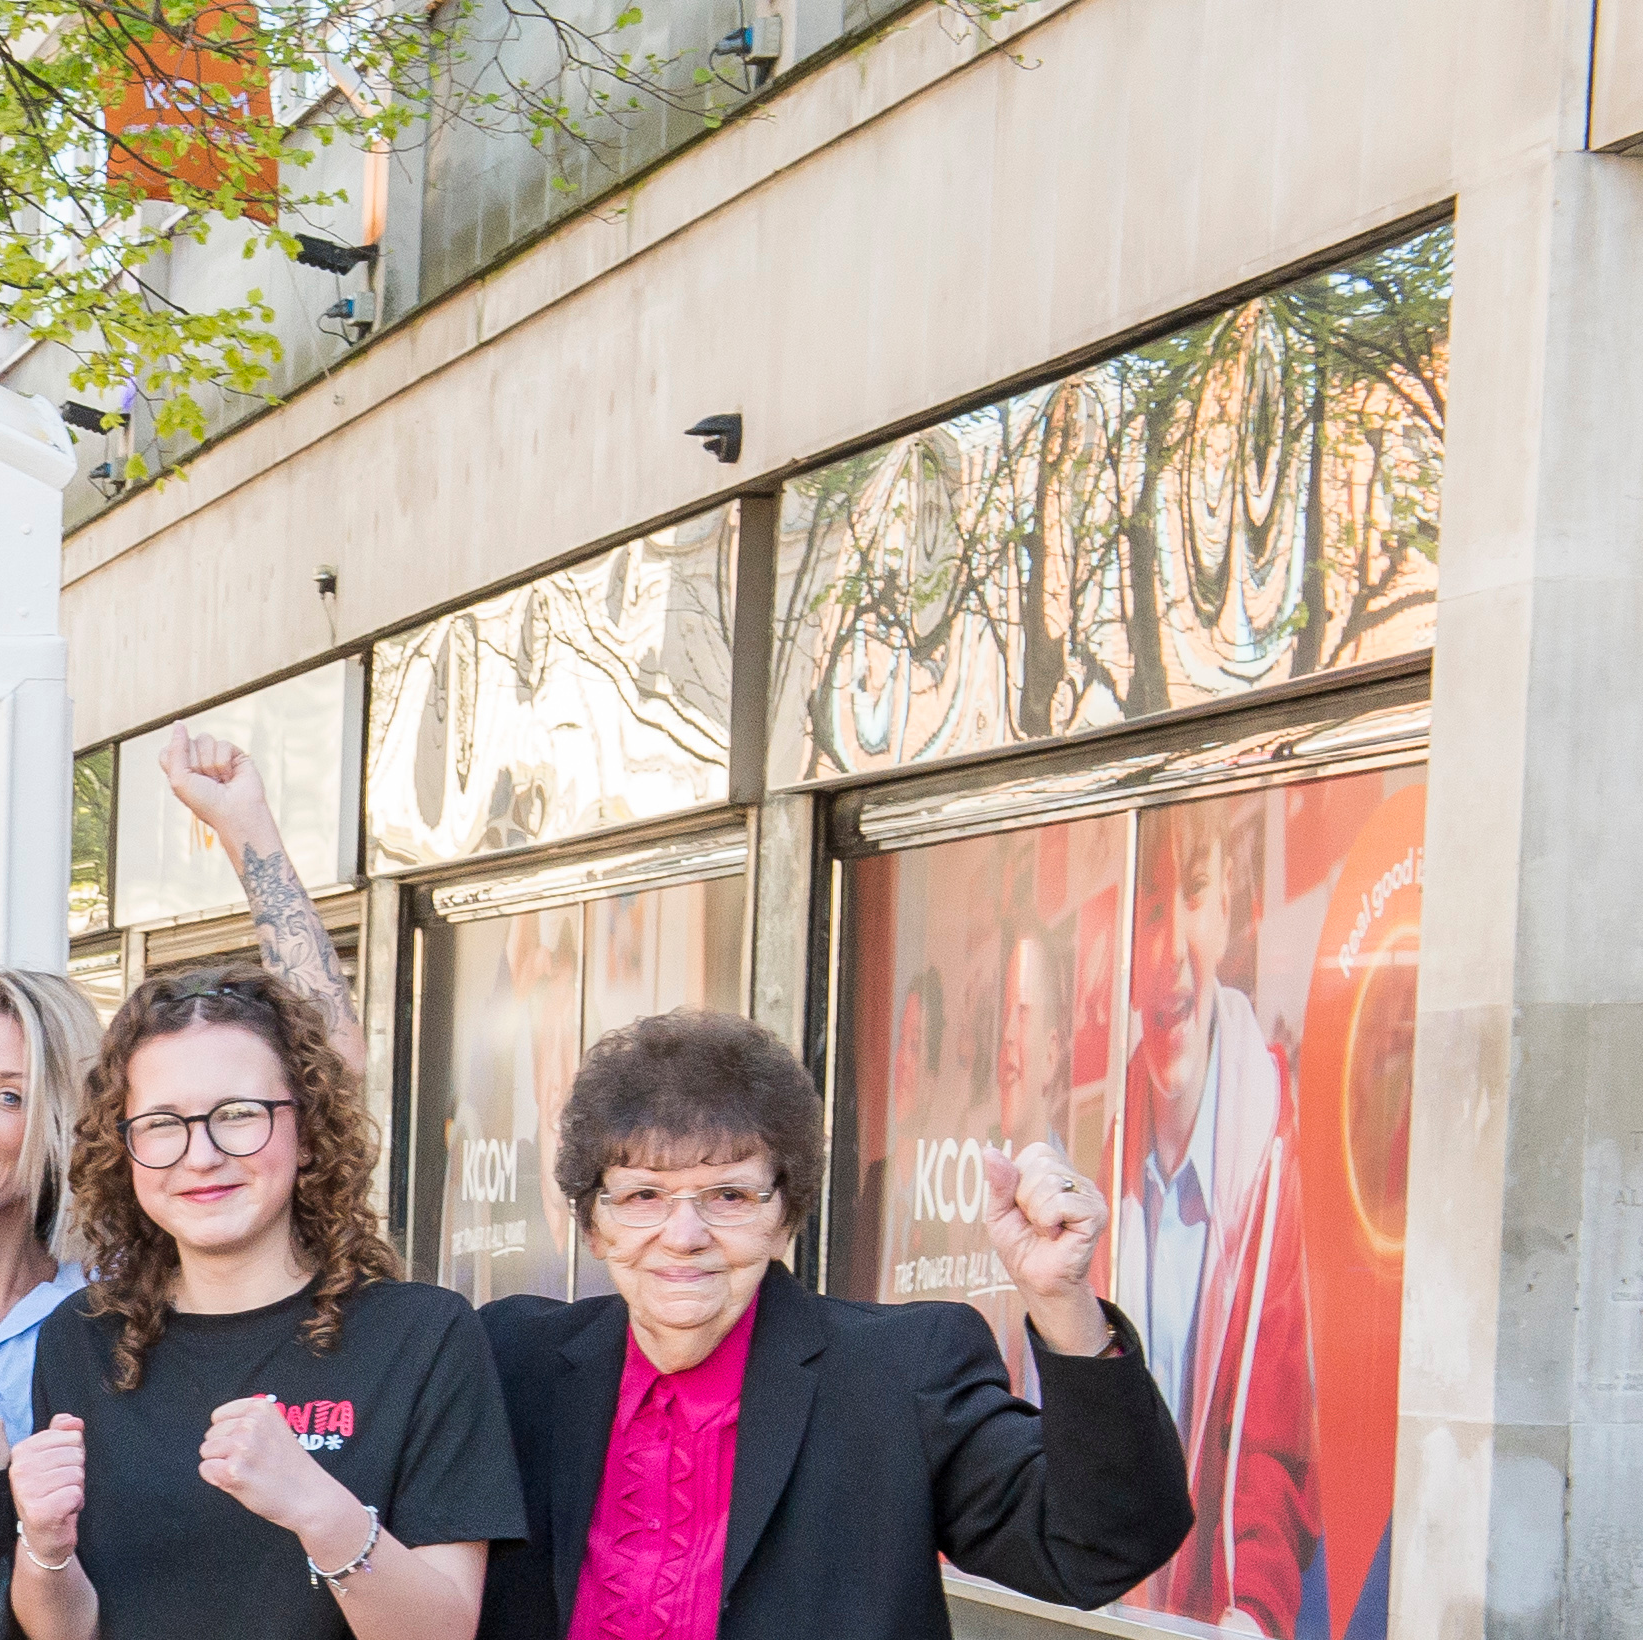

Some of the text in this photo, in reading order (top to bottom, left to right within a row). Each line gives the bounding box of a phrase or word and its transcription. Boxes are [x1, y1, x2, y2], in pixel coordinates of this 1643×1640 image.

[1338, 892, 1372, 979] Real
[1371, 847, 1414, 918] good
[461, 1139, 517, 1202] KCOM
[914, 1137, 1013, 1223] KCO
